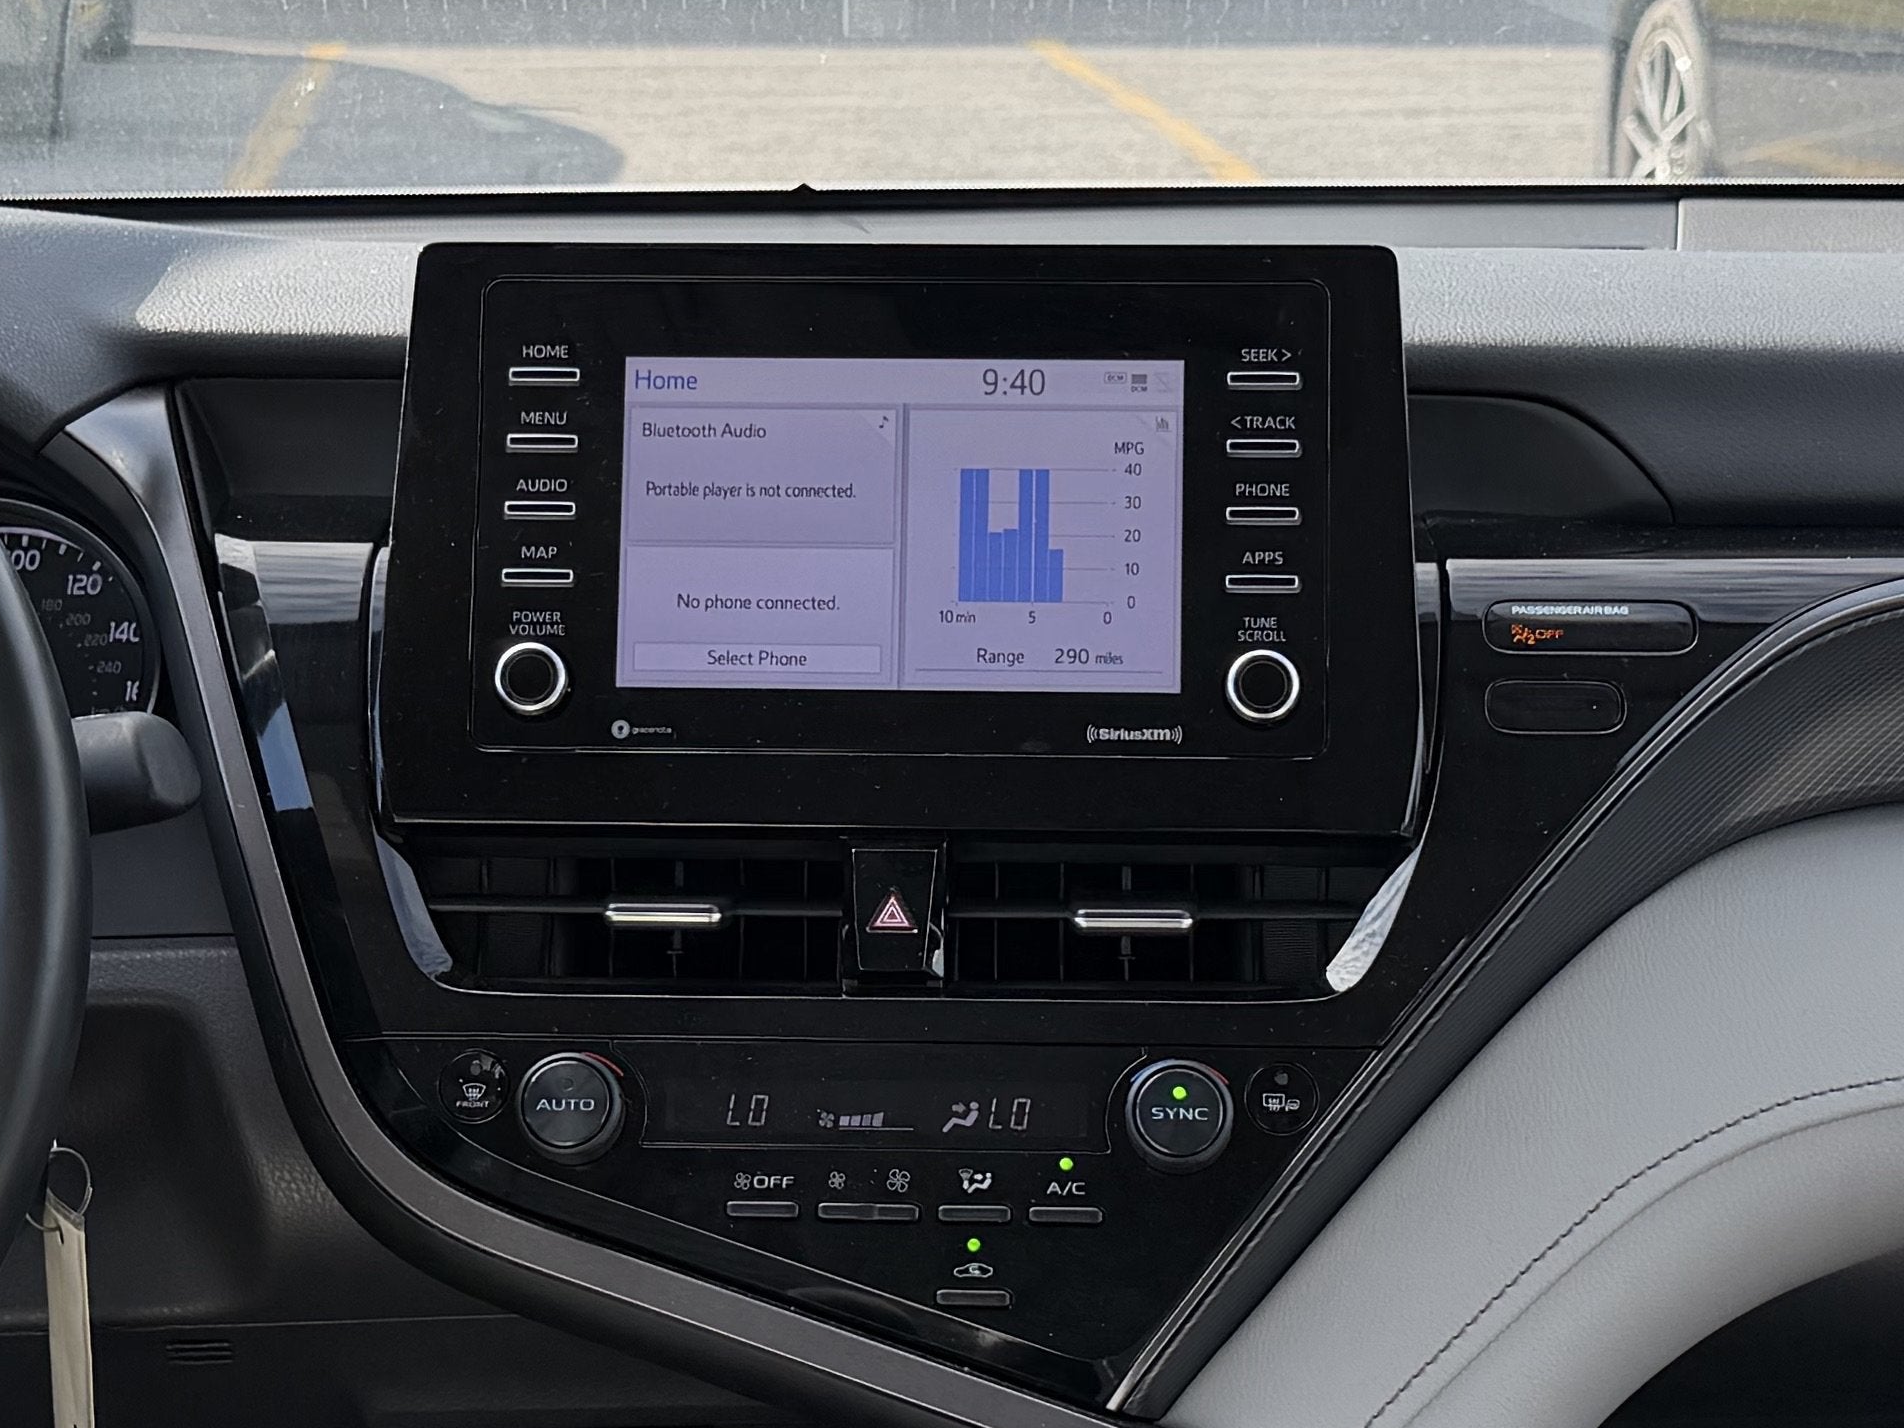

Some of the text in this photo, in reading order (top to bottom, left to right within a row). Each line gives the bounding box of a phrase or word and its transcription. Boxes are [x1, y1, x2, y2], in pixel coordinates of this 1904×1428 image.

[521, 344, 570, 360] HOME
[1240, 348, 1278, 363] SEEK
[634, 370, 699, 392] Home
[982, 368, 1046, 397] 9:40
[520, 410, 569, 426] MENU
[1243, 415, 1296, 430] TRACK
[642, 421, 767, 439] Bluetooth Audio
[1113, 441, 1145, 457] MPG
[1123, 462, 1142, 478] 40
[516, 478, 569, 493] AUDIO
[645, 480, 857, 503] Portable player is not connected.
[1234, 482, 1291, 497] PHONE
[1123, 495, 1143, 511] 30
[1123, 528, 1142, 544] 20
[10, 549, 41, 571] 00
[520, 545, 558, 560] MAP
[1241, 551, 1285, 565] APPS
[1123, 562, 1141, 577] 10
[66, 573, 104, 596] 120
[676, 593, 842, 616] No phone connected.
[1125, 595, 1137, 611] 0
[1511, 604, 1583, 616] PASSENGER
[1582, 604, 1604, 616] AIR
[65, 612, 92, 627] 200
[512, 610, 563, 624] POWER
[939, 609, 977, 625] 10 min
[1027, 610, 1037, 625] 5
[1102, 610, 1113, 626] 0
[1242, 616, 1278, 629] TUNE
[508, 623, 567, 637] VOLUME
[1236, 629, 1288, 643] SCROLL
[83, 632, 108, 647] 220
[707, 649, 808, 668] Select Phone
[976, 646, 1125, 667] Range 290 miles
[535, 1096, 595, 1112] AUTO
[726, 1093, 770, 1127] LO
[990, 1097, 1032, 1131] LO
[1150, 1106, 1209, 1121] SYNC
[753, 1174, 794, 1189] OFF
[1046, 1181, 1086, 1197] A/C
